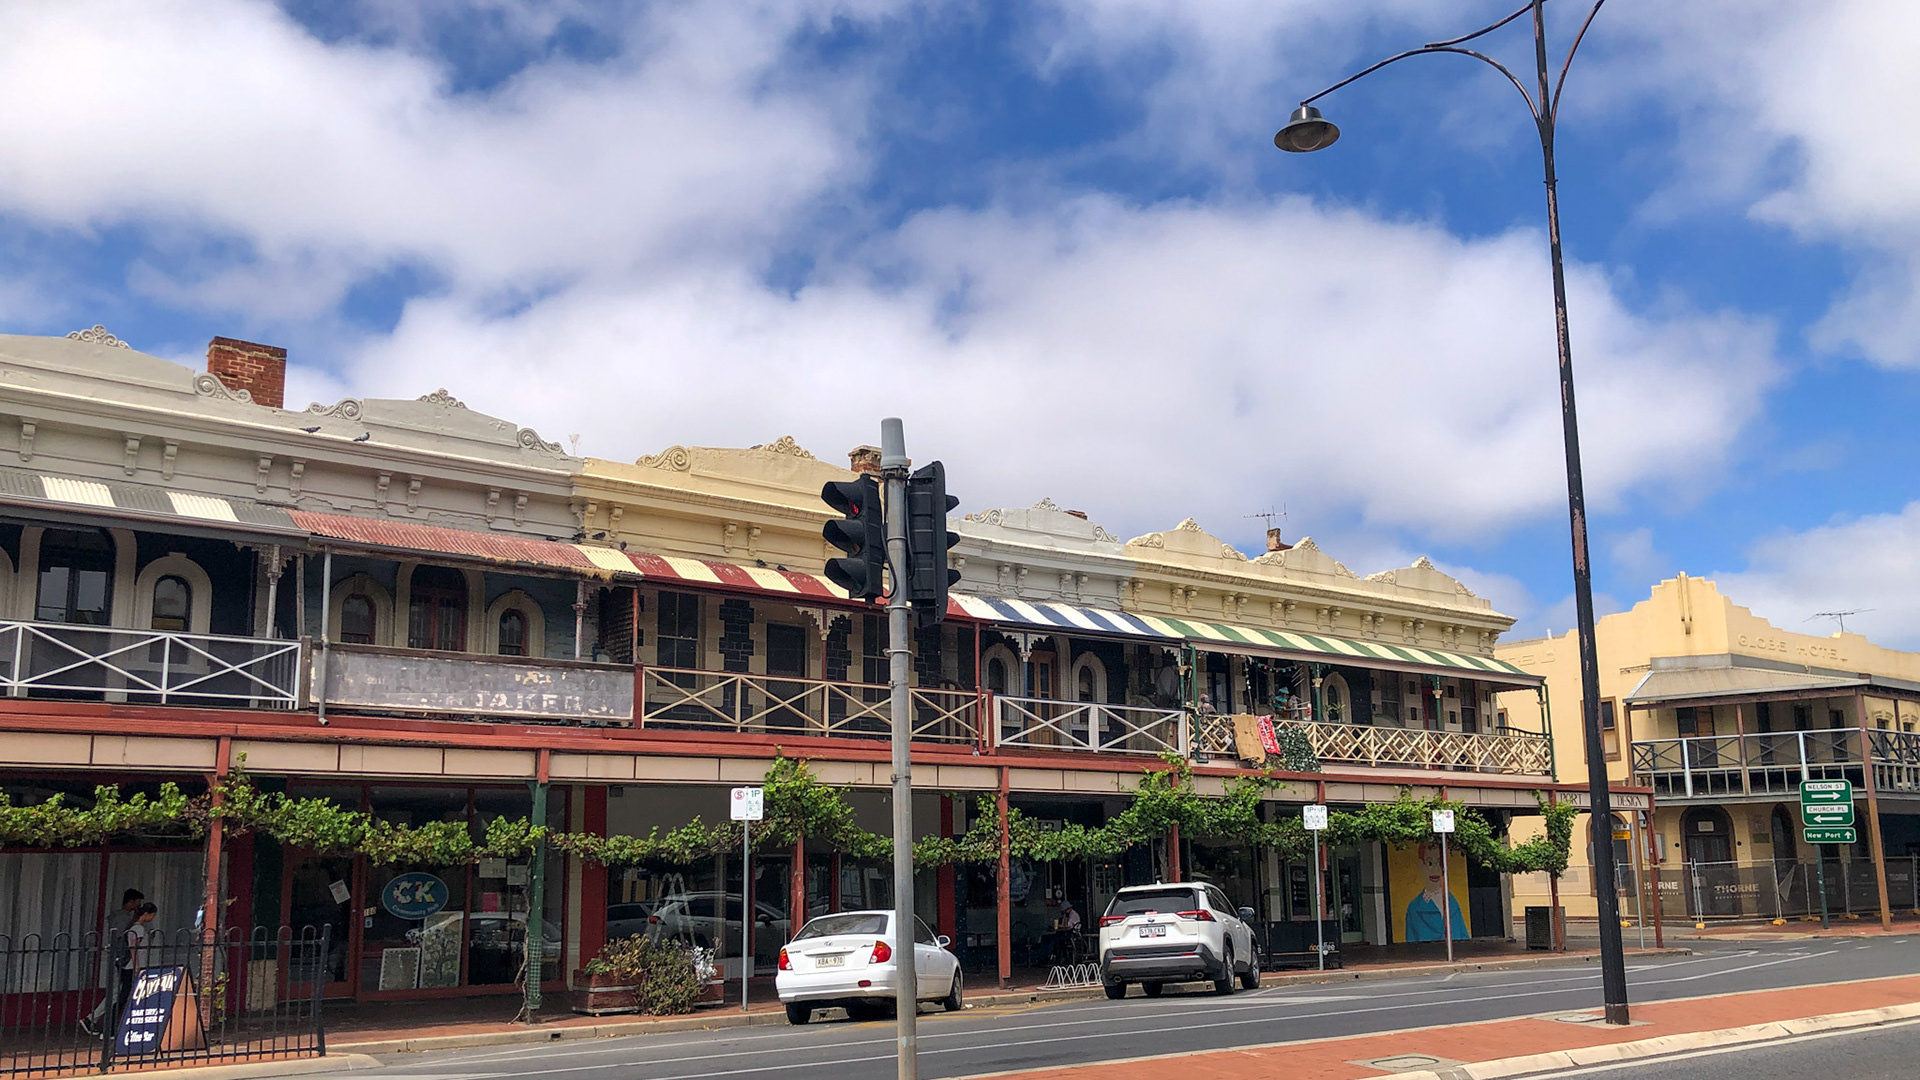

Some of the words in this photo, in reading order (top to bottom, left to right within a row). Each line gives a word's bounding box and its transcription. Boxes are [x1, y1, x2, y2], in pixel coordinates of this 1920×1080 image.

[1738, 634, 1787, 652] GLOBE
[1796, 645, 1848, 662] HOTEL
[751, 789, 761, 798] 1P
[1560, 793, 1582, 806] PORT
[1616, 795, 1642, 807] DESIGN
[1643, 881, 1679, 890] HRNE
[1714, 883, 1760, 894] THORNE
[393, 881, 436, 903] CK
